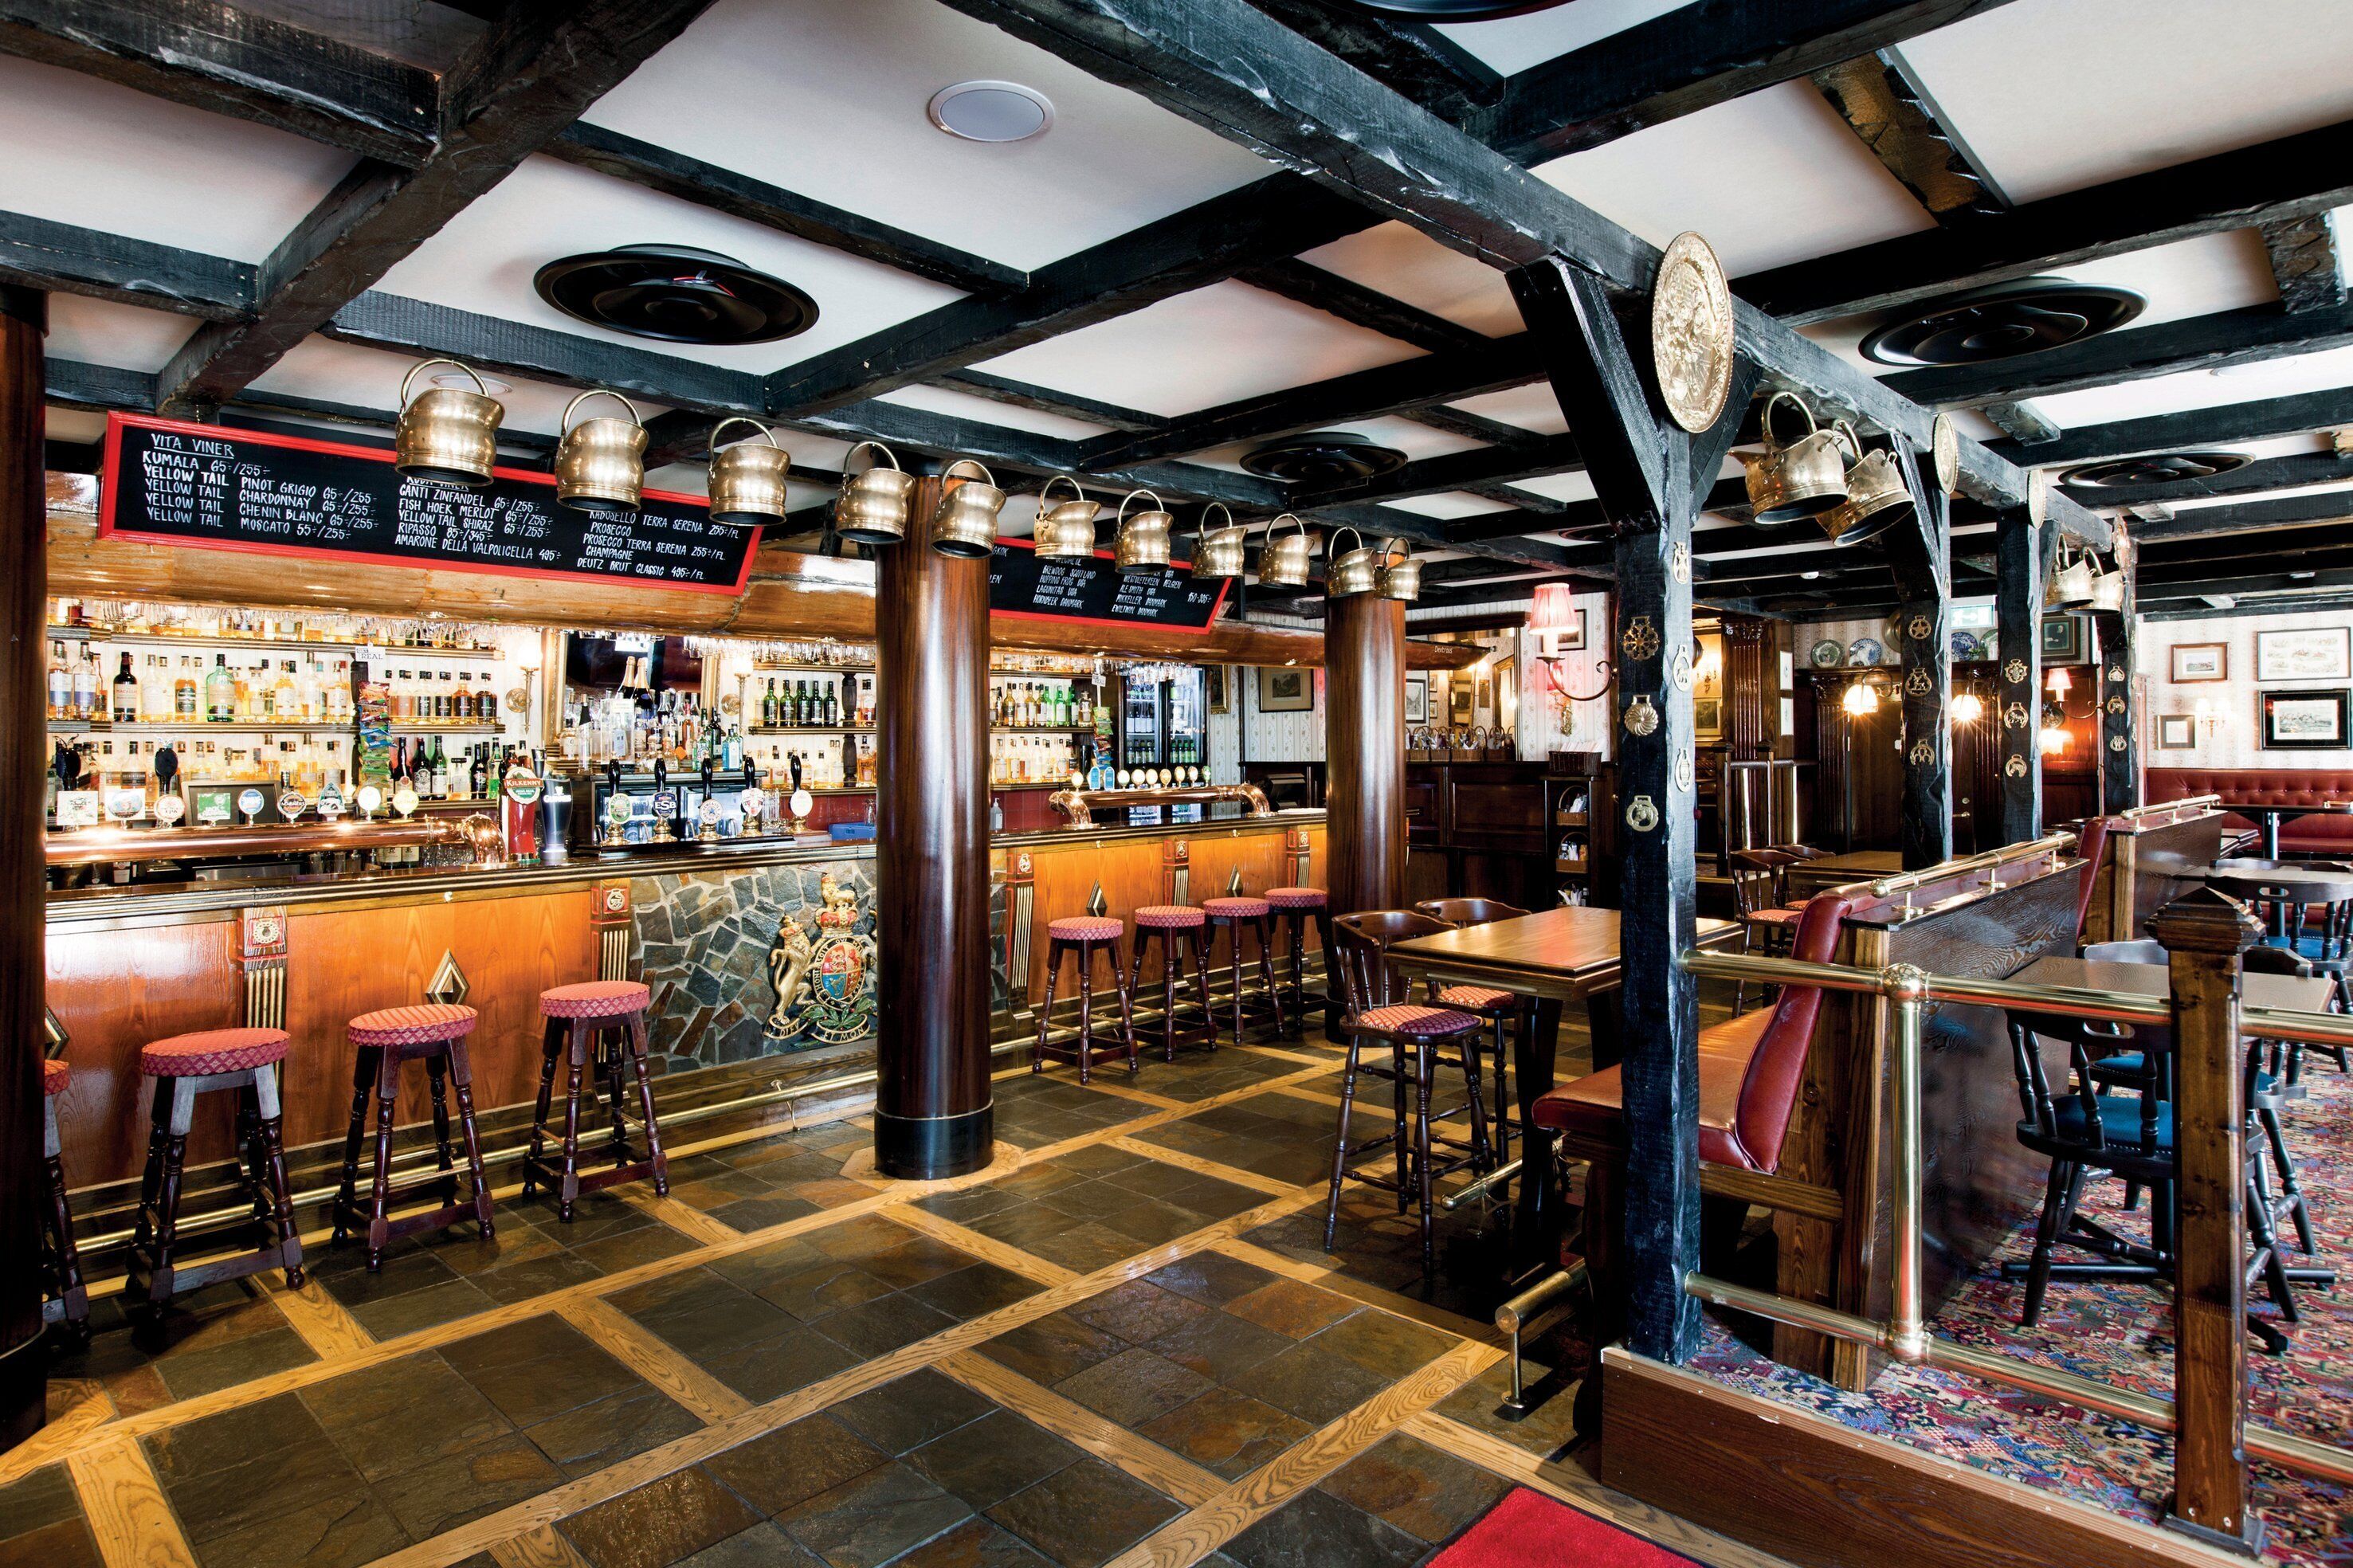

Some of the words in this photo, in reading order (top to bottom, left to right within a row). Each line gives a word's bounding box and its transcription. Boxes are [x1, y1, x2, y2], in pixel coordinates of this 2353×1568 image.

[151, 433, 182, 449] VITA
[192, 439, 234, 457] VINER
[143, 451, 199, 469] KUMALA
[143, 464, 194, 481] YELLOW
[201, 472, 229, 485] TAIL
[241, 476, 276, 491] PINOT
[280, 481, 316, 498] GRIGIO
[145, 478, 192, 495] YELLOW
[198, 484, 225, 499] TAIL
[239, 489, 311, 509] CHARDONNAY
[399, 484, 429, 499] CANTI
[433, 489, 485, 507] ZINFANDEL
[146, 492, 193, 509] YELLOW
[199, 499, 224, 512] TAIL
[239, 503, 280, 519] CHENIN
[286, 508, 323, 523] BLANC
[399, 498, 422, 510] FISH
[427, 502, 453, 515] HOEK
[459, 505, 500, 519] MERLOT
[147, 507, 192, 523] YELLOW
[199, 513, 223, 527] TAIL
[241, 518, 290, 534] MOSCATO
[398, 509, 435, 524] YELLOW
[438, 515, 457, 527] TAIL
[463, 517, 494, 531] SHIRAZ
[398, 522, 437, 536] RIPASSO
[590, 521, 632, 537] PROSECCO
[642, 514, 668, 528] TERRA
[673, 519, 704, 533] SERENA
[394, 534, 438, 548] AMARONE
[442, 538, 468, 552] DELLA
[473, 542, 533, 559] VALPOLICELLA
[582, 533, 623, 547] PROSECCO
[626, 539, 652, 551] TERRA
[656, 542, 687, 555] SERENA
[586, 545, 634, 560] CHAMPAGNE
[577, 558, 604, 570] DEUTZ
[610, 560, 632, 572] BRUT
[635, 563, 665, 576] CLASSIC
[1042, 564, 1066, 576] BREWDOG
[1061, 576, 1074, 586] FROG
[1036, 584, 1065, 595] LAGUNITAS
[1067, 587, 1077, 597] USA
[1060, 598, 1084, 610] DANMARK
[1145, 597, 1167, 608] DANMARK
[654, 800, 677, 810] ESB
